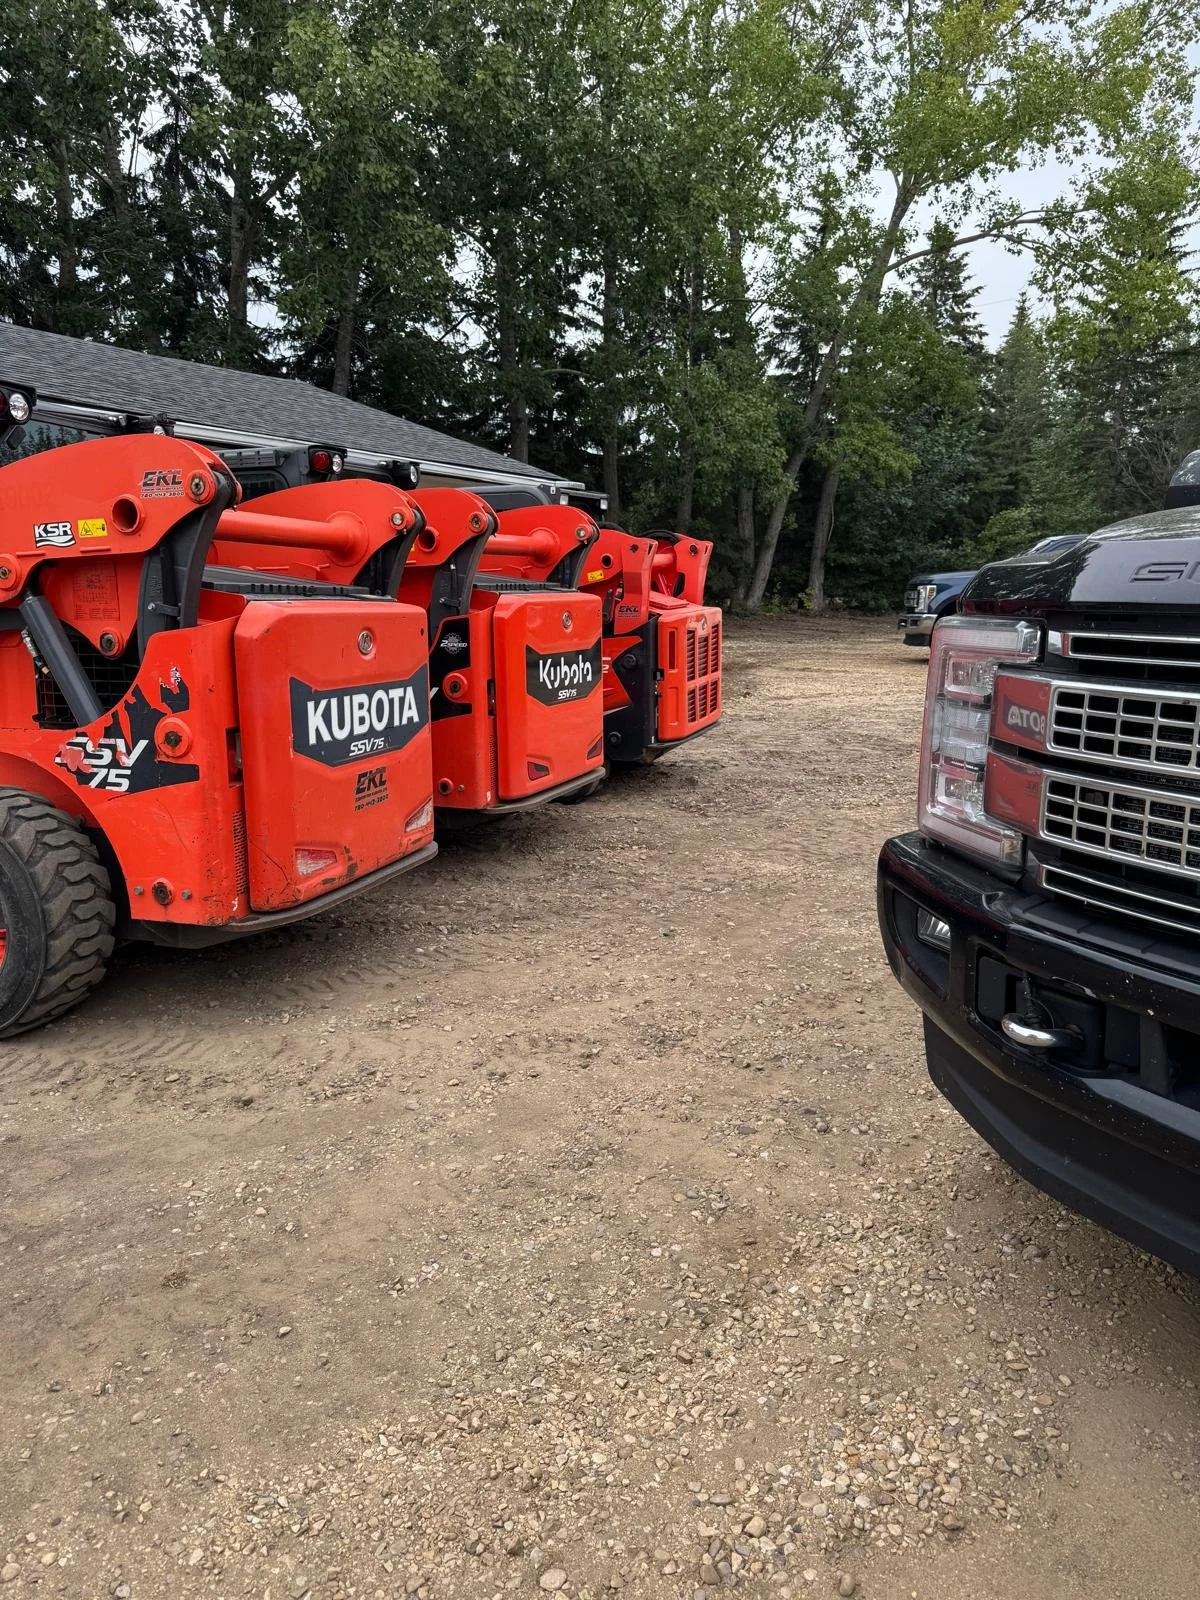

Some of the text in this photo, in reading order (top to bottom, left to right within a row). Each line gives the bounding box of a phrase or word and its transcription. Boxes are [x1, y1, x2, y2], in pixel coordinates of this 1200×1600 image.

[142, 470, 183, 487] EKL
[34, 522, 72, 538] KSR
[1129, 562, 1200, 584] S
[539, 654, 592, 690] Kubota
[307, 685, 420, 746] KUBOTA
[88, 767, 131, 792] 75
